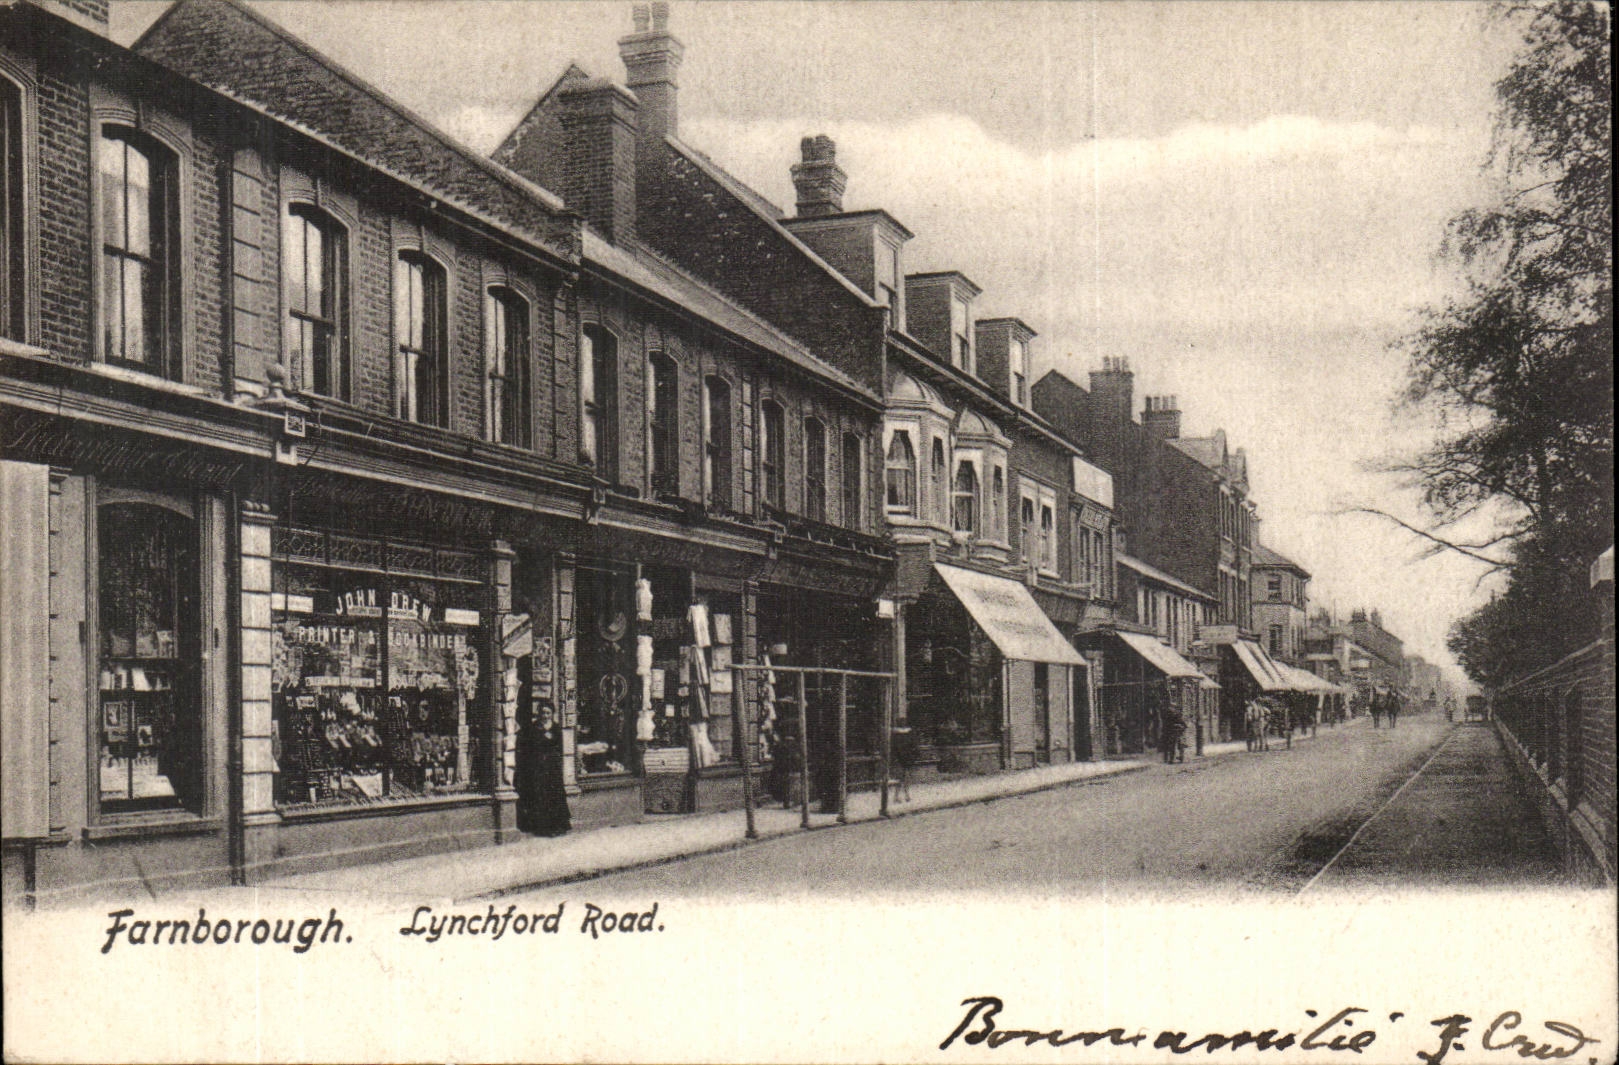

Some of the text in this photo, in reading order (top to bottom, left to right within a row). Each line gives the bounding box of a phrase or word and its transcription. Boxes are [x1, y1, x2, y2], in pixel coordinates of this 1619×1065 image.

[335, 588, 376, 616] JOHN
[391, 591, 432, 622] DREW
[298, 625, 356, 646] PRINTER
